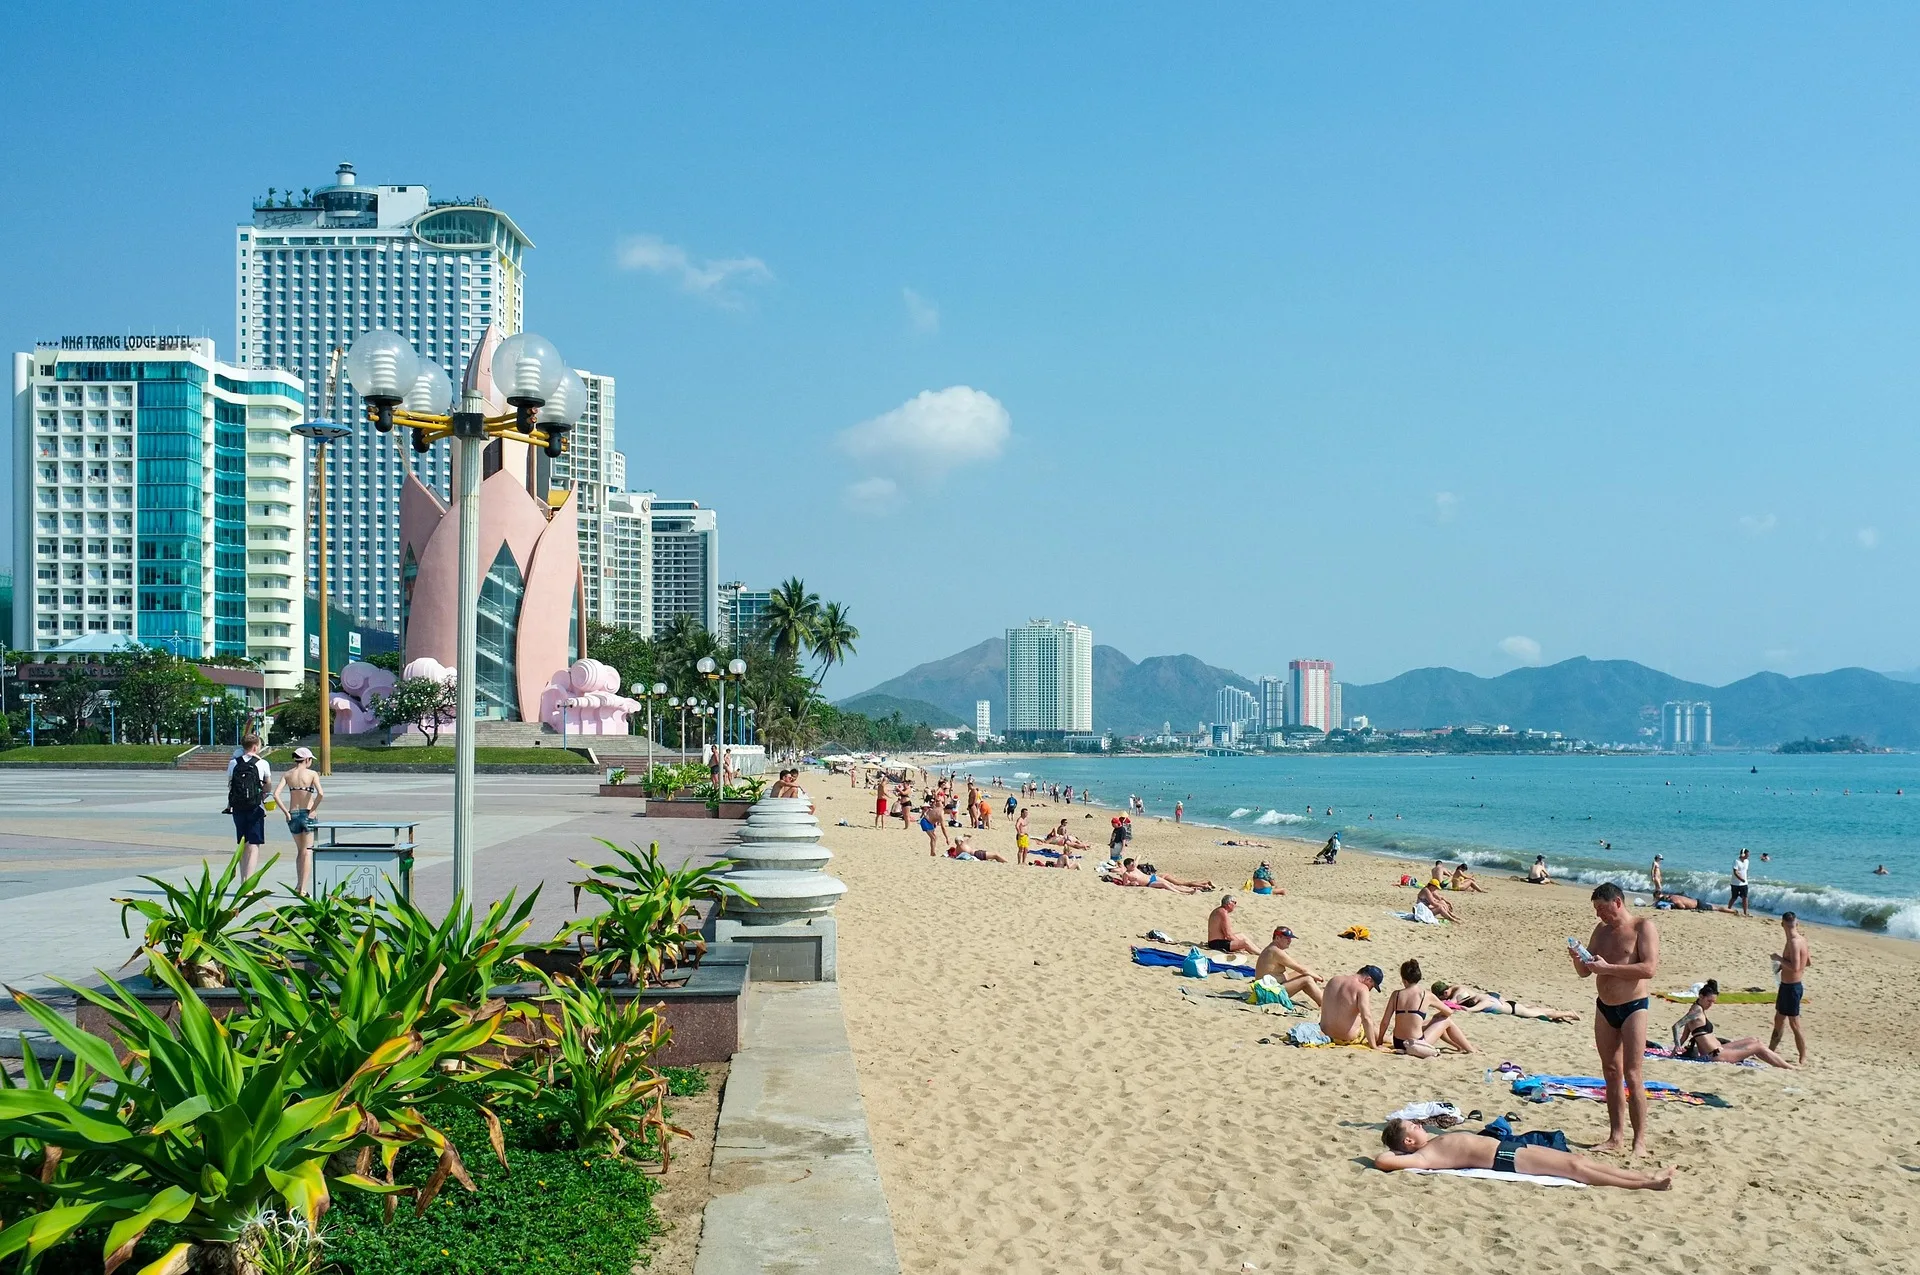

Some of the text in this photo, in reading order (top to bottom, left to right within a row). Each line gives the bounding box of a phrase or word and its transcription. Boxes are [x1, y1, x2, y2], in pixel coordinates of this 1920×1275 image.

[61, 335, 192, 350] NHA TRANG LODGE HOTEL
